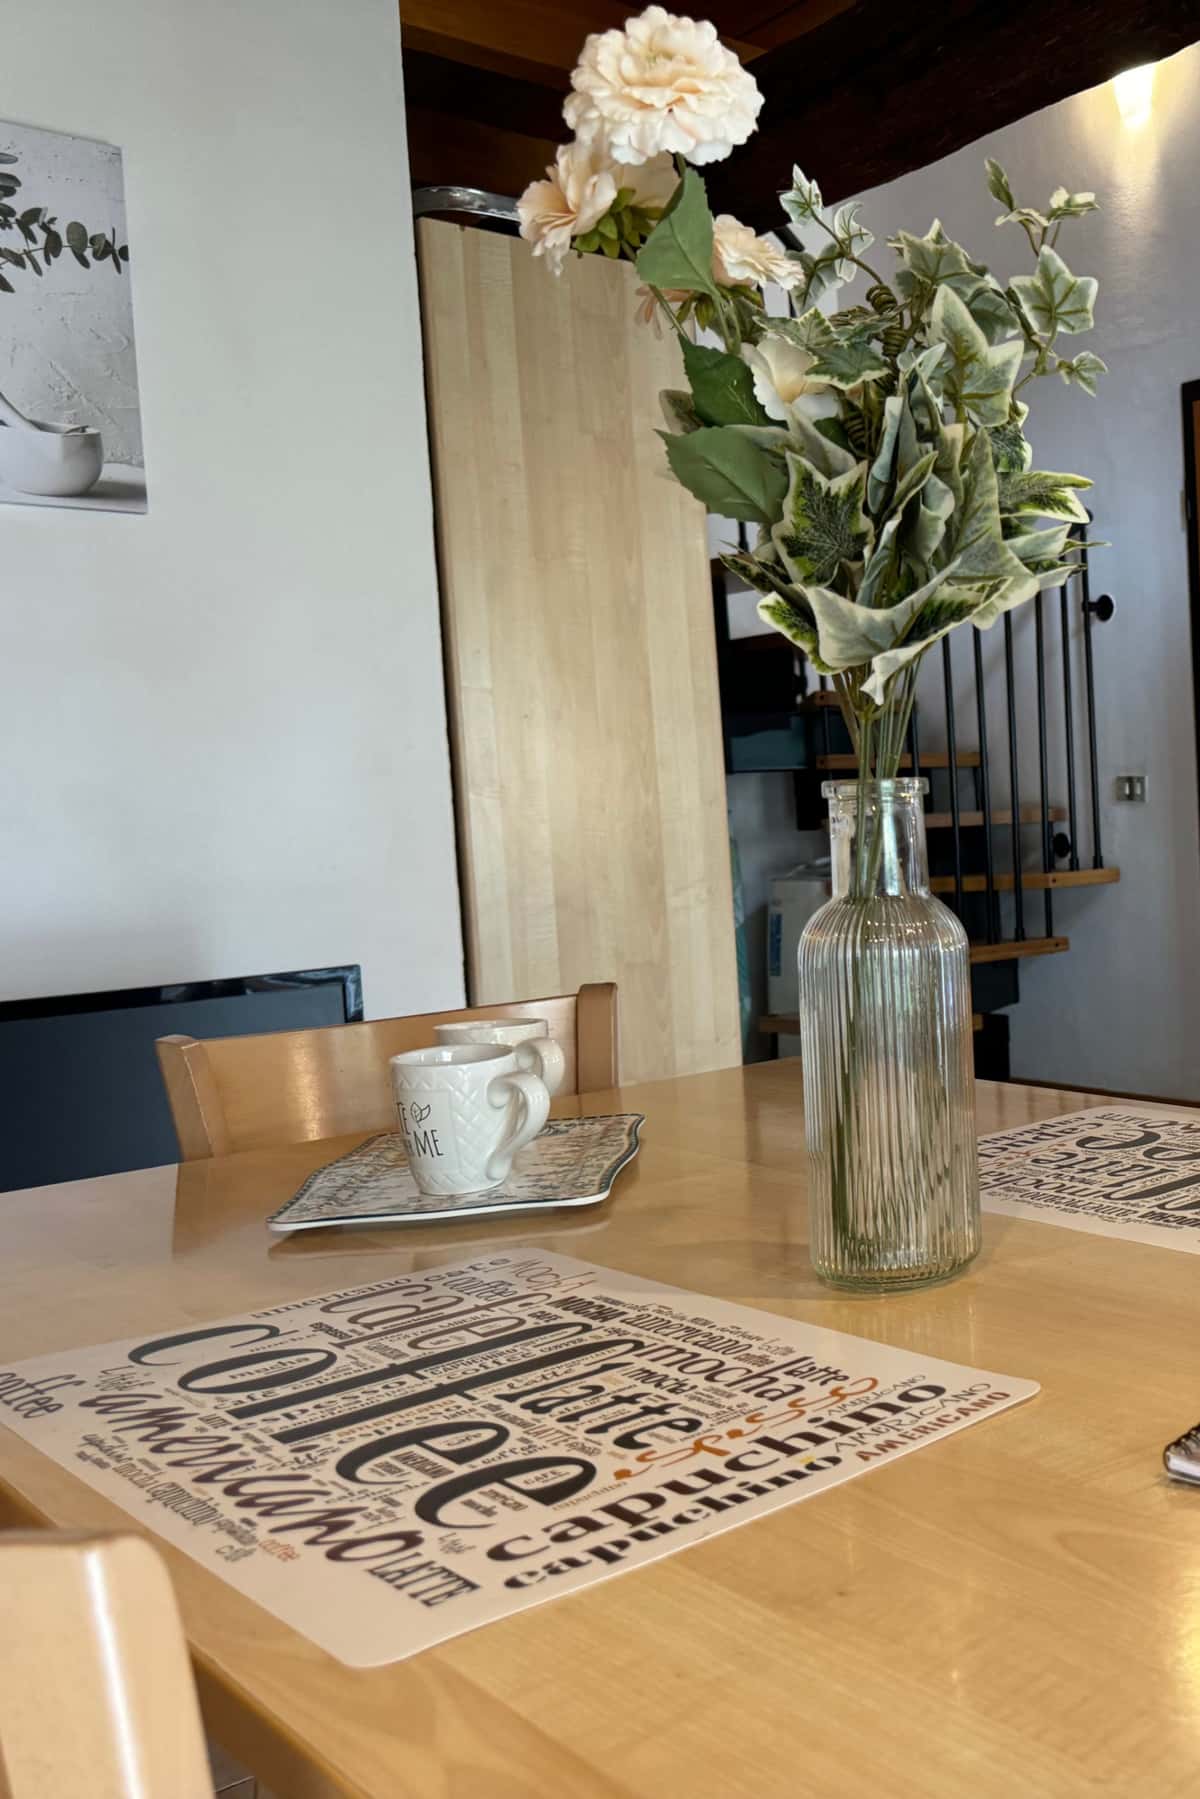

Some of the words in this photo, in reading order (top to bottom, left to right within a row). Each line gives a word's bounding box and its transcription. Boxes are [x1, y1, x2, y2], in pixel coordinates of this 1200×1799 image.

[412, 1129, 444, 1158] ME
[1029, 1151, 1181, 1188] latte
[1009, 1191, 1138, 1216] americano
[423, 1258, 510, 1282] cafe
[442, 1276, 534, 1301] coffee
[252, 1278, 411, 1318] americano
[319, 1283, 553, 1350] cafe
[547, 1296, 626, 1322] MOCHA
[620, 1313, 751, 1354] americano
[228, 1357, 309, 1379] mocha
[446, 1352, 535, 1379] coffee
[622, 1367, 697, 1394] mocha
[633, 1343, 813, 1401] mocha
[783, 1361, 849, 1385] latte
[493, 1362, 703, 1449] latte
[128, 1322, 643, 1528] coffee
[522, 1424, 577, 1446] LATTE
[78, 1393, 425, 1562] americano
[487, 1384, 947, 1560] capuchino
[504, 1456, 842, 1588] capuchino
[365, 1551, 481, 1607] LATTE
